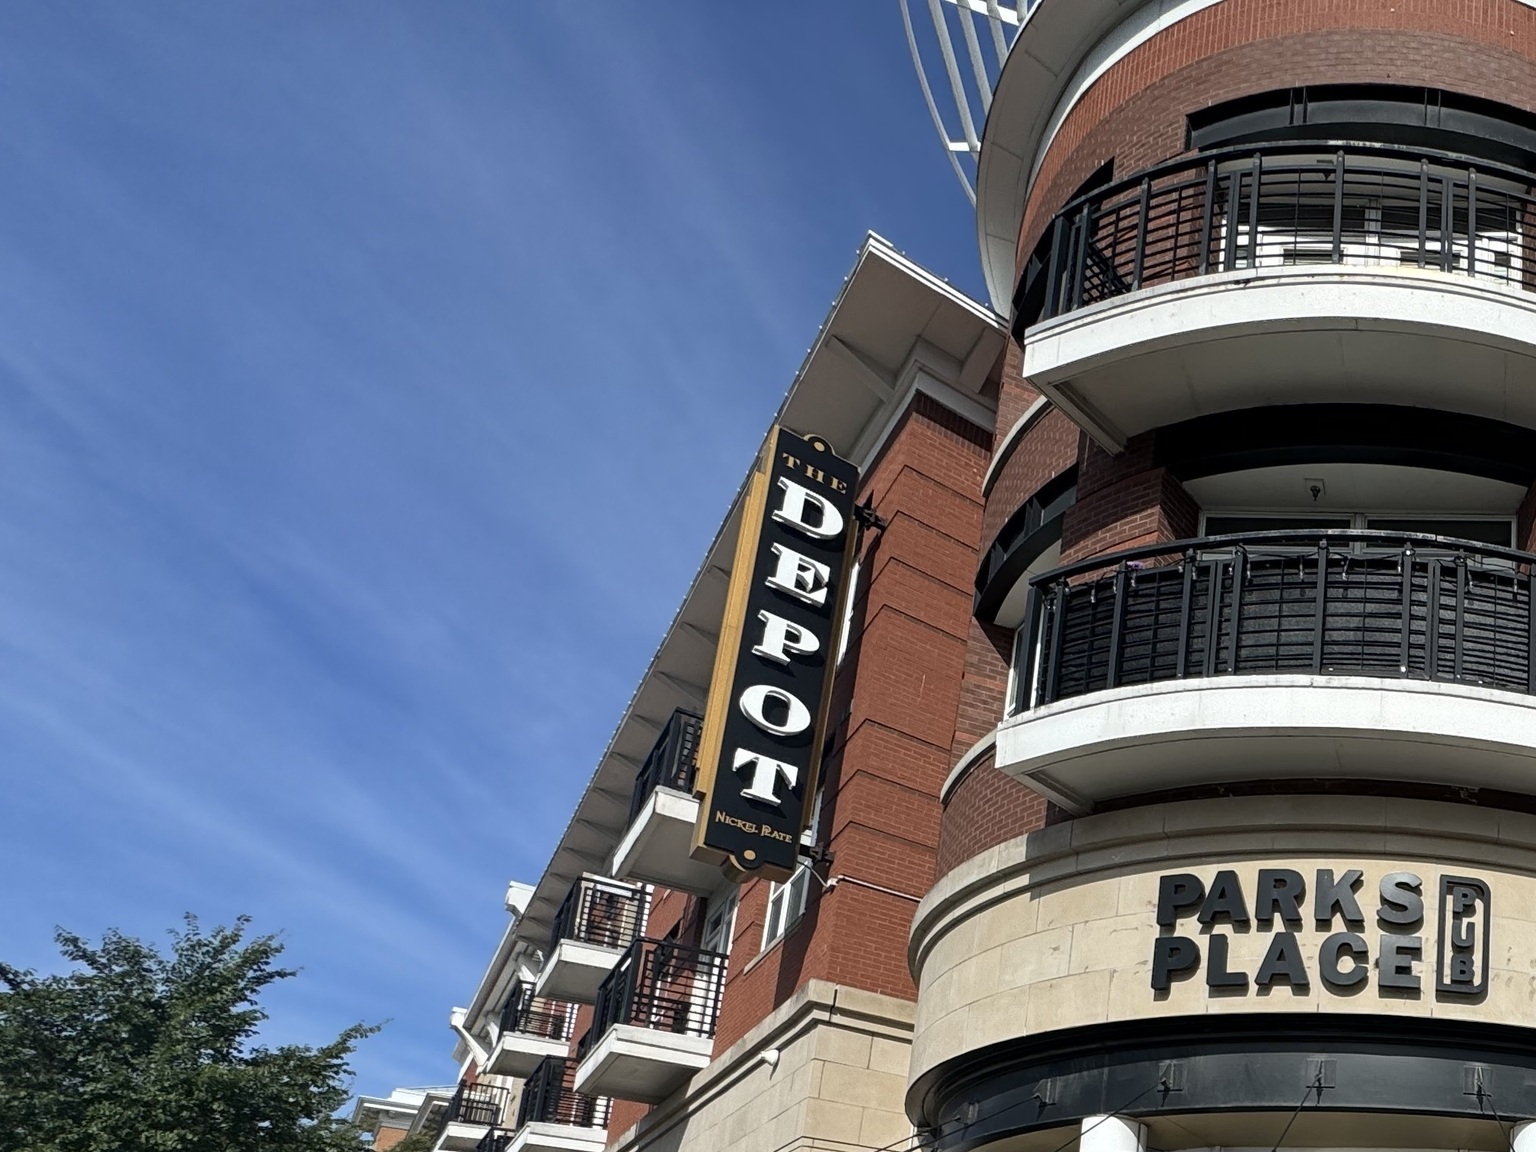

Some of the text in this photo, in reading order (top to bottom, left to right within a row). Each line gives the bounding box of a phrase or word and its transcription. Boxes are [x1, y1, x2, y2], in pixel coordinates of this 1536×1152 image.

[782, 452, 848, 495] THE
[732, 476, 844, 807] DEPOT
[715, 810, 793, 844] NICKEL PLATE
[1156, 868, 1425, 928] PARKS
[1150, 931, 1423, 991] PLACE
[1450, 887, 1476, 982] PUB
